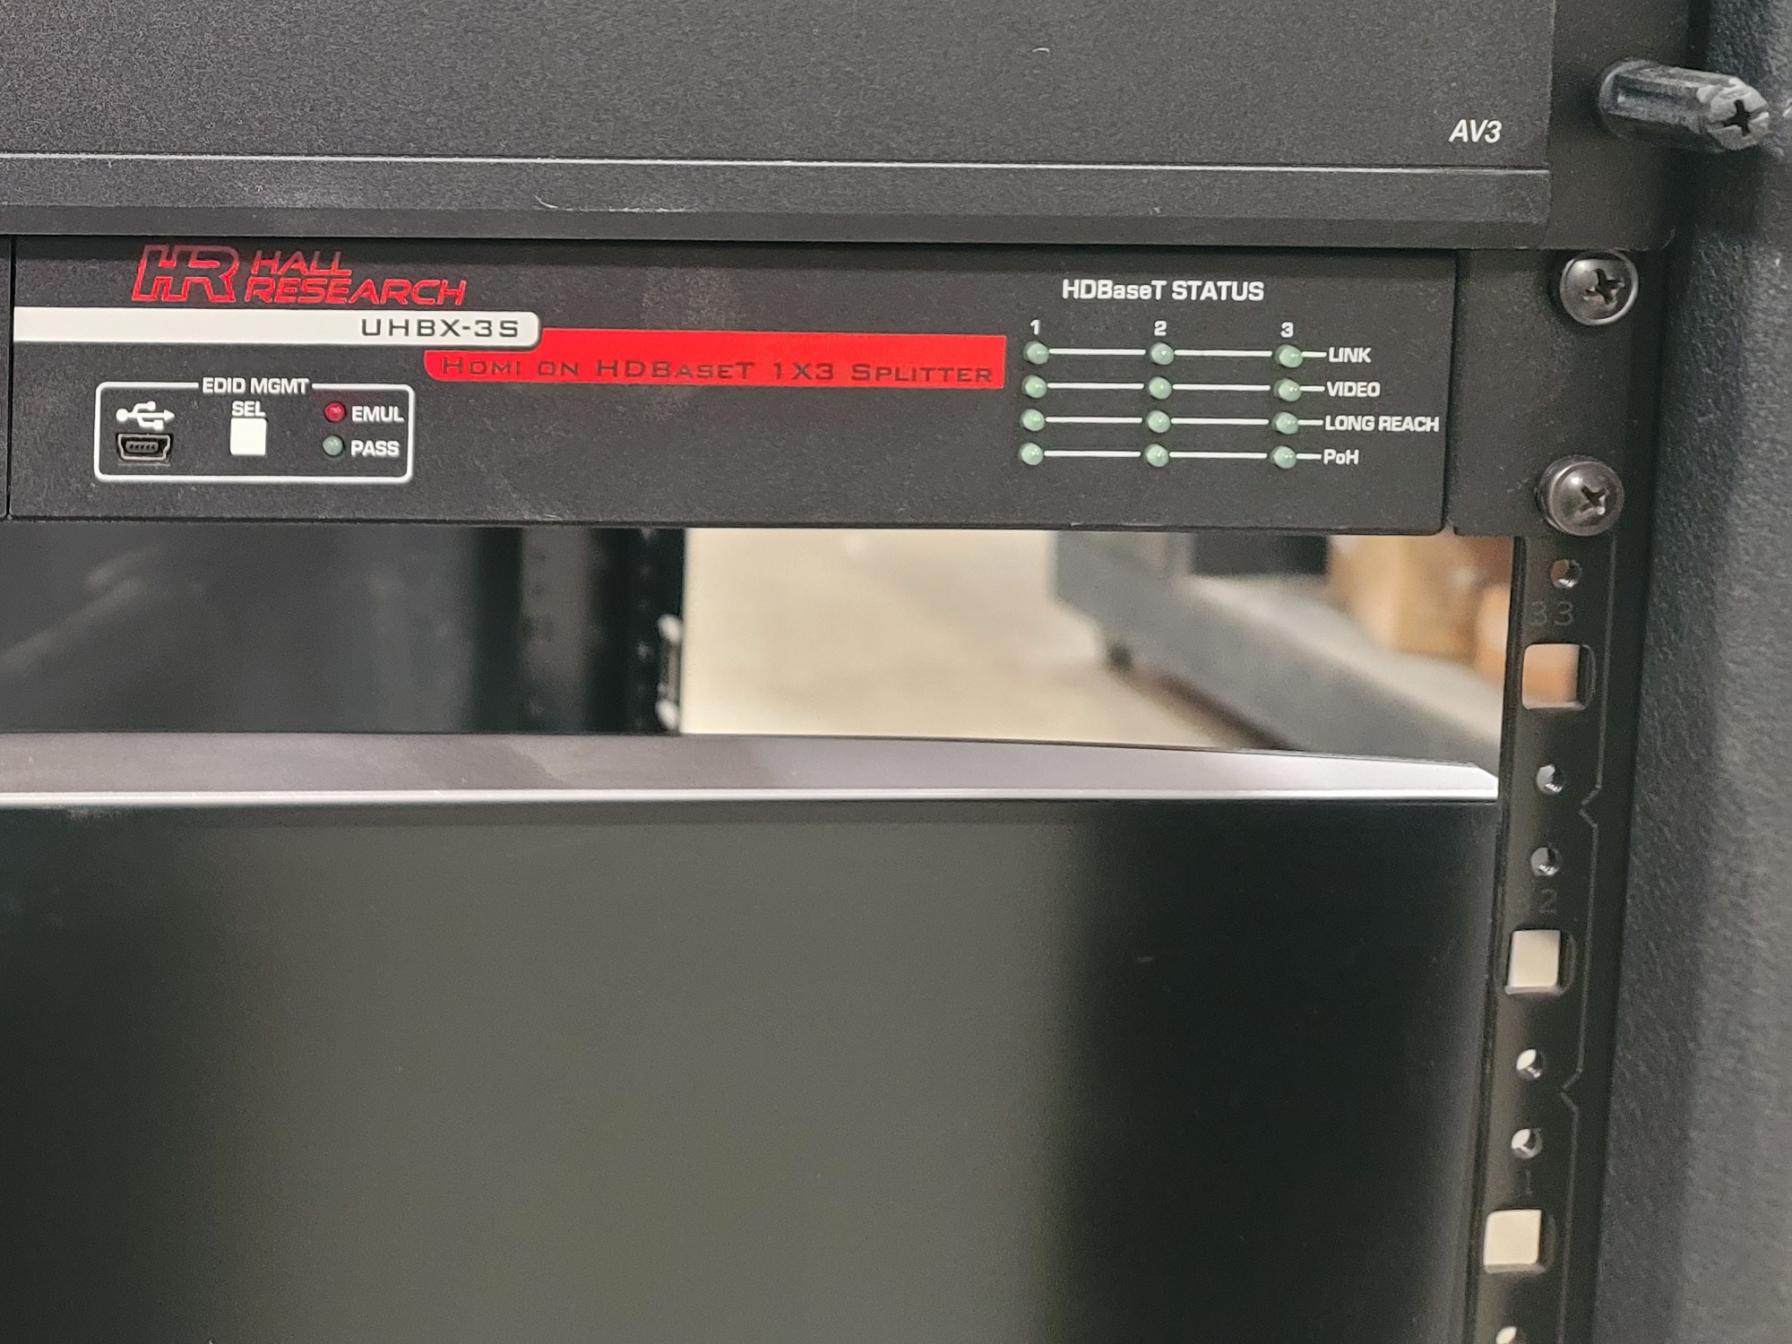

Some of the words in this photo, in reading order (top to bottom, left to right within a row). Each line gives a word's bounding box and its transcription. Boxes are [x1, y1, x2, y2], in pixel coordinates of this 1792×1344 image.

[1448, 119, 1502, 144] AV3
[248, 253, 352, 275] HALL
[244, 277, 467, 306] RESEARCH
[1062, 278, 1168, 300] HDBaseT
[1171, 280, 1265, 301] STATUS
[361, 318, 518, 338] UHBX-3S
[1030, 319, 1040, 335] 1
[1154, 320, 1167, 336] 2
[1280, 321, 1294, 338] 3
[1328, 346, 1372, 363] LINK
[202, 377, 246, 394] EDID
[250, 377, 310, 395] MGMT
[1326, 381, 1381, 398] VIDEO
[231, 401, 266, 418] SEL
[351, 405, 405, 423] EMUL
[1325, 415, 1375, 432] LONG
[1377, 415, 1440, 432] REACH
[350, 439, 400, 457] PASS
[1323, 448, 1360, 465] PoH
[1528, 599, 1575, 627] 33
